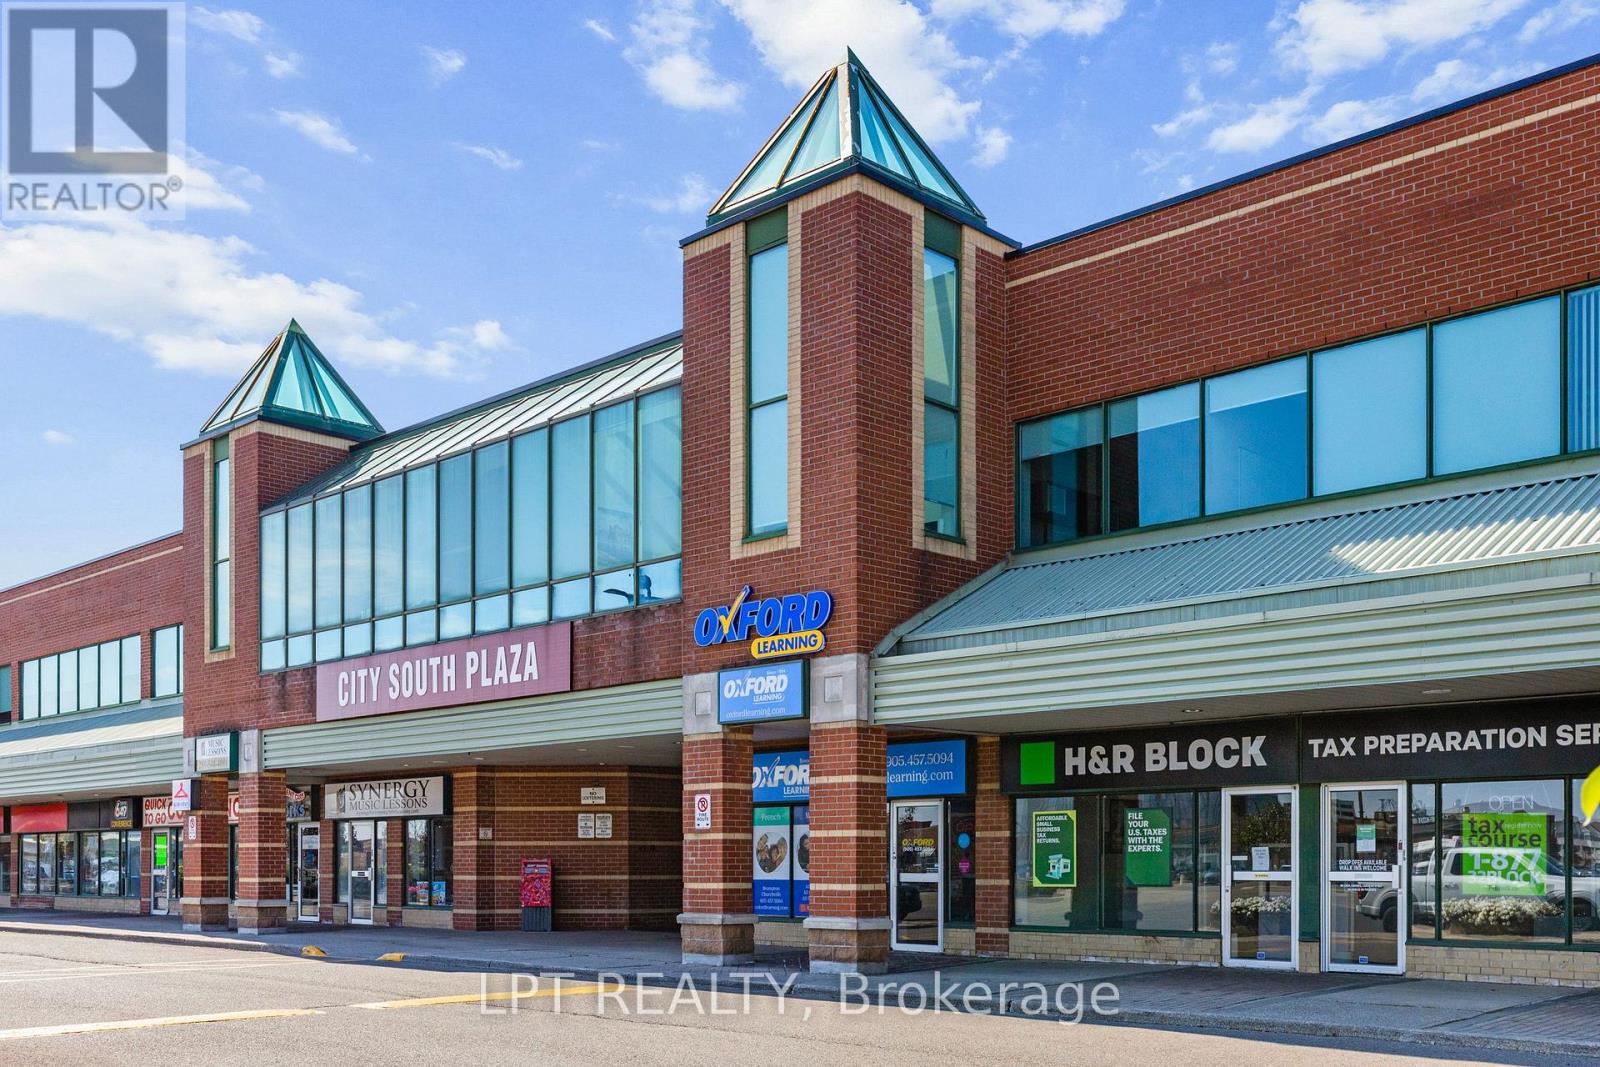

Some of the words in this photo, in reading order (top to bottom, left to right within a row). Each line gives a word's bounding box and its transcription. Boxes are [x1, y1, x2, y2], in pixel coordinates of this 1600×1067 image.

[694, 585, 831, 647] OXFORD
[757, 634, 818, 655] LEARNING
[338, 666, 381, 707] CITY
[388, 654, 456, 700] SOUTH
[466, 641, 539, 689] PLAZA
[723, 670, 789, 699] OXFORD
[753, 693, 784, 702] LEARNING
[1308, 736, 1357, 758] TAX
[1363, 726, 1548, 756] PREPARATION
[886, 752, 954, 768] 905.457.5094
[1065, 745, 1135, 776] H&R
[1145, 735, 1268, 772] BLOCK
[349, 779, 430, 802] SYNERGY
[144, 797, 167, 811] QUICK
[349, 799, 379, 811] MUSIC
[382, 797, 429, 810] LESSONS
[1488, 795, 1535, 811] OPEN
[144, 813, 153, 825] TO
[155, 812, 167, 824] GO
[1127, 812, 1144, 820] FILE
[1127, 820, 1149, 828] YOUR
[1127, 828, 1142, 836] U.S.
[1142, 828, 1168, 836] TAXES
[1467, 816, 1506, 834] tax
[1127, 836, 1148, 844] WITH
[1148, 836, 1164, 844] THE
[1127, 844, 1163, 852] EXPERTS.
[1467, 833, 1542, 848] course
[1468, 847, 1542, 871] 1-877
